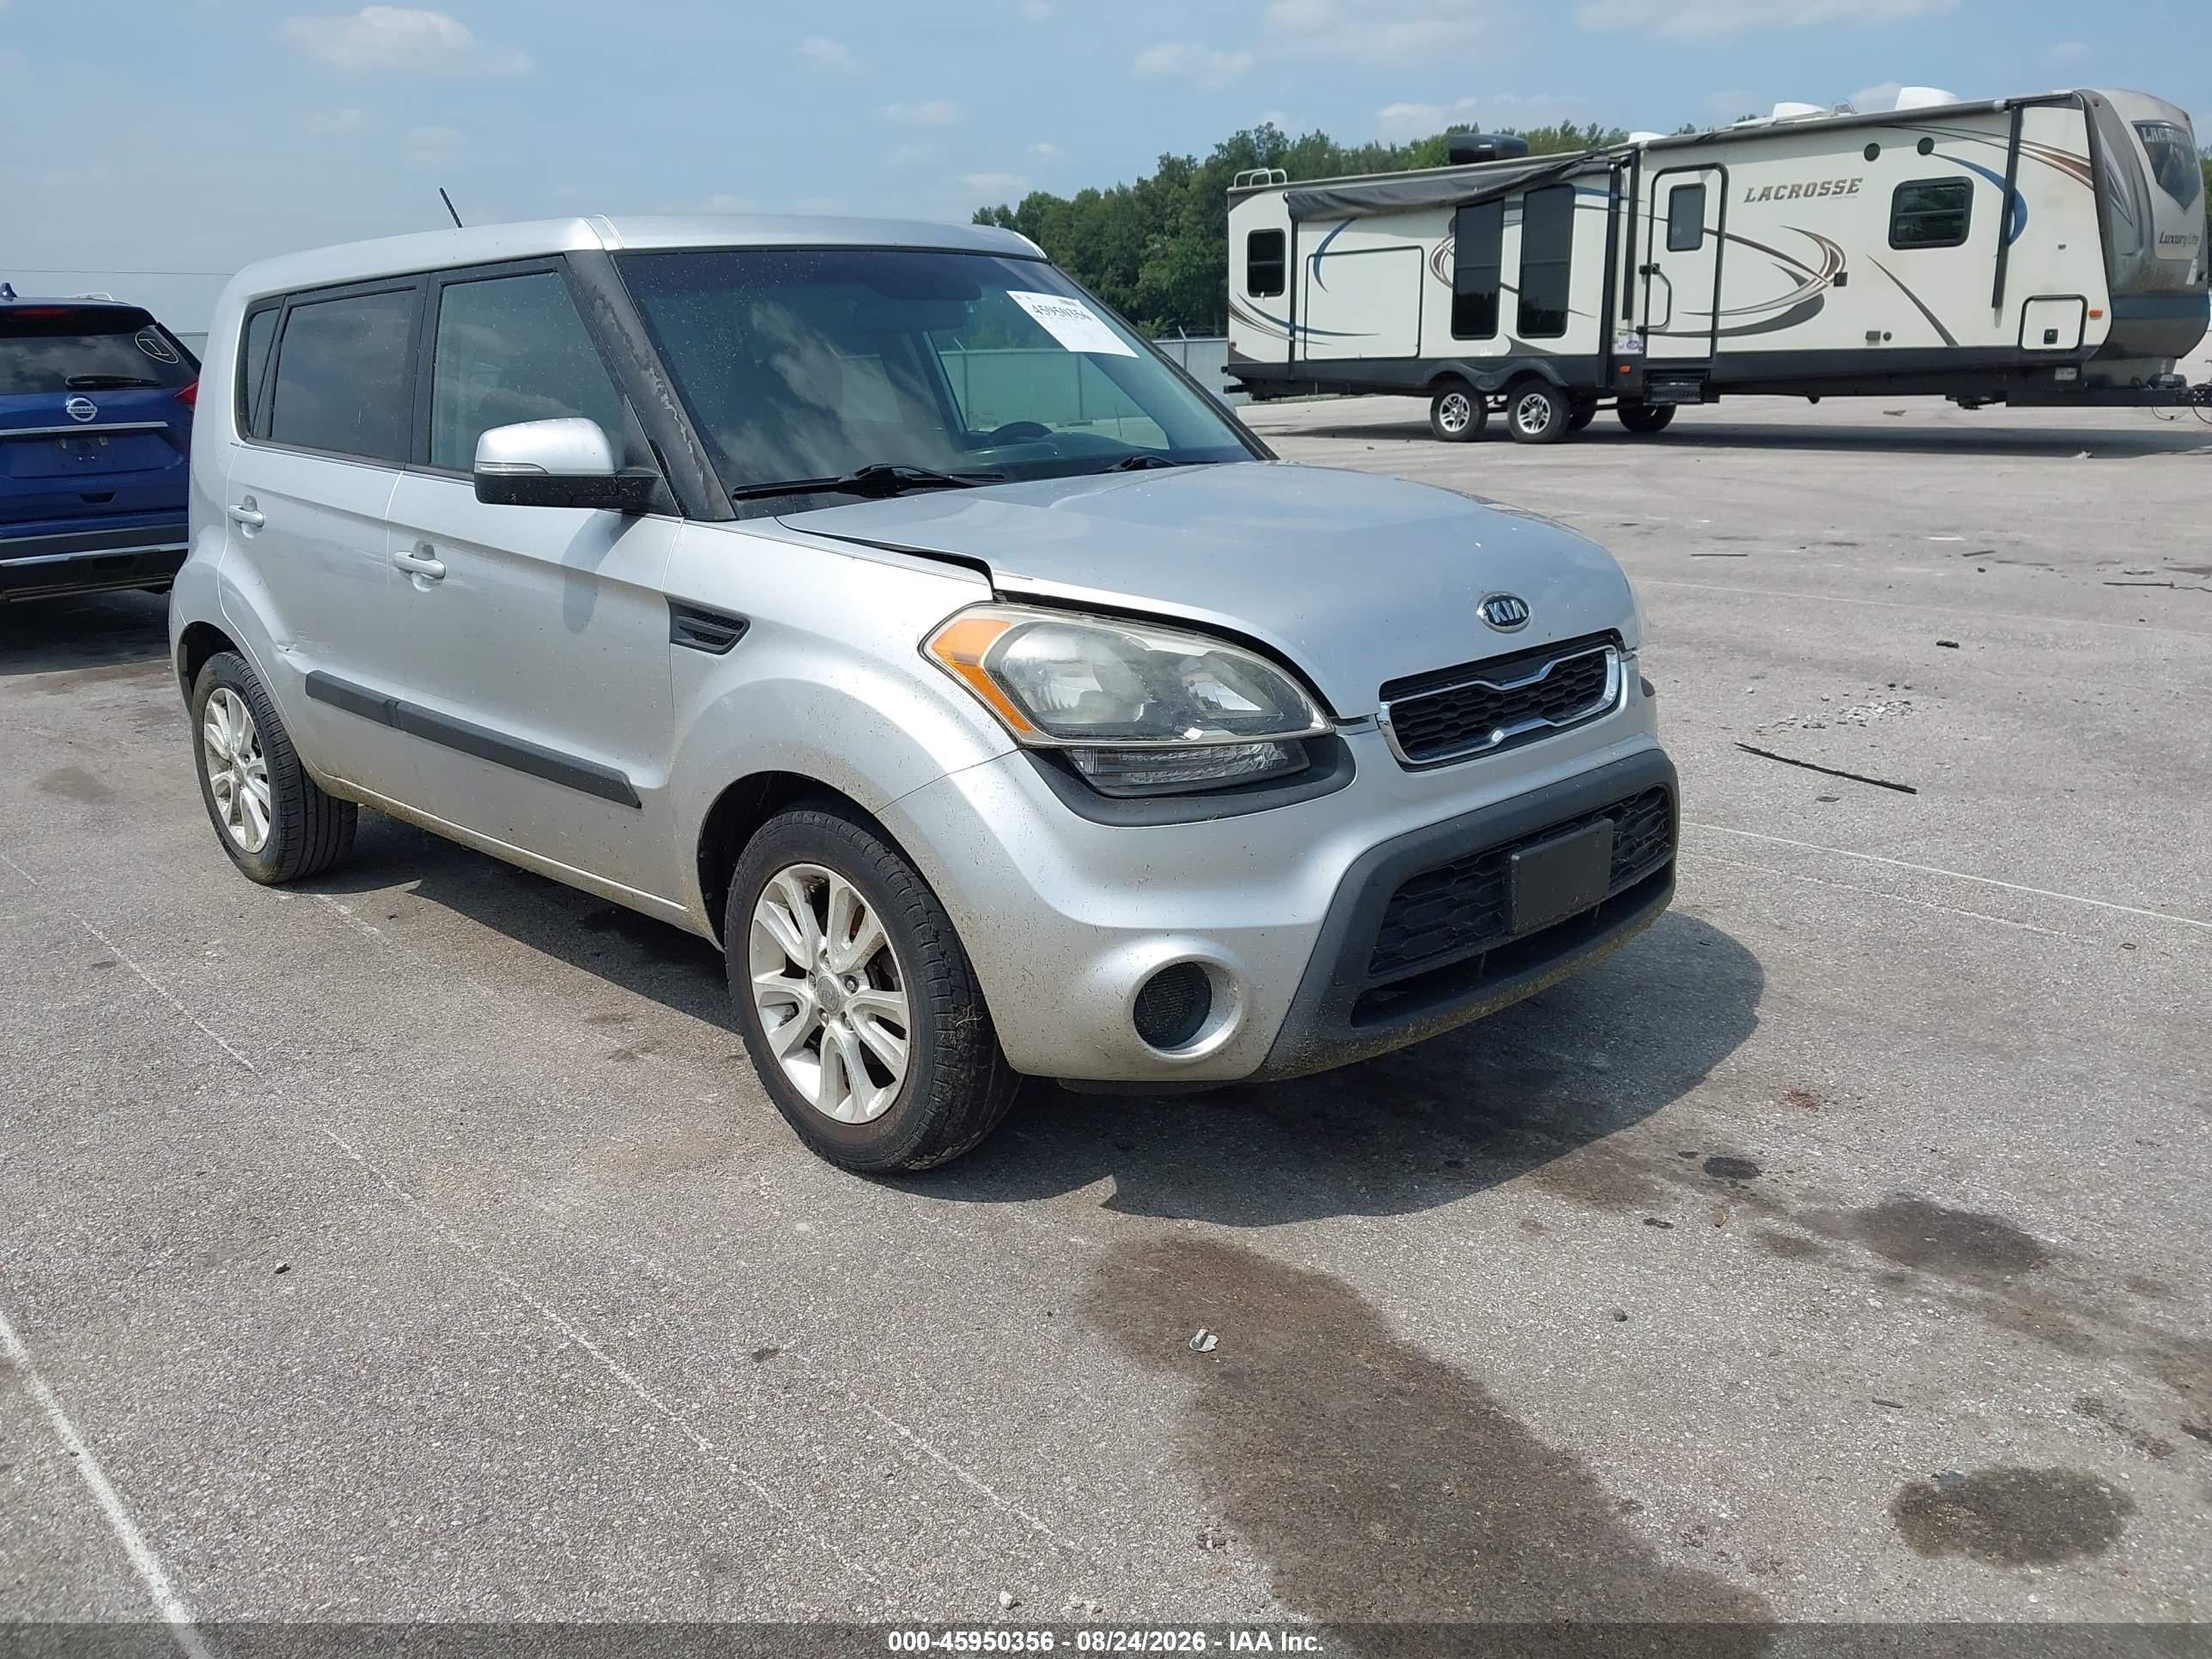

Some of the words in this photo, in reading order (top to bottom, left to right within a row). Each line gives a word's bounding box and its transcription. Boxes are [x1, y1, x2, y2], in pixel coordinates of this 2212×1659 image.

[1743, 177, 1863, 203] LACROSSE
[2158, 231, 2187, 247] Luxury
[1486, 599, 1527, 623] KIA
